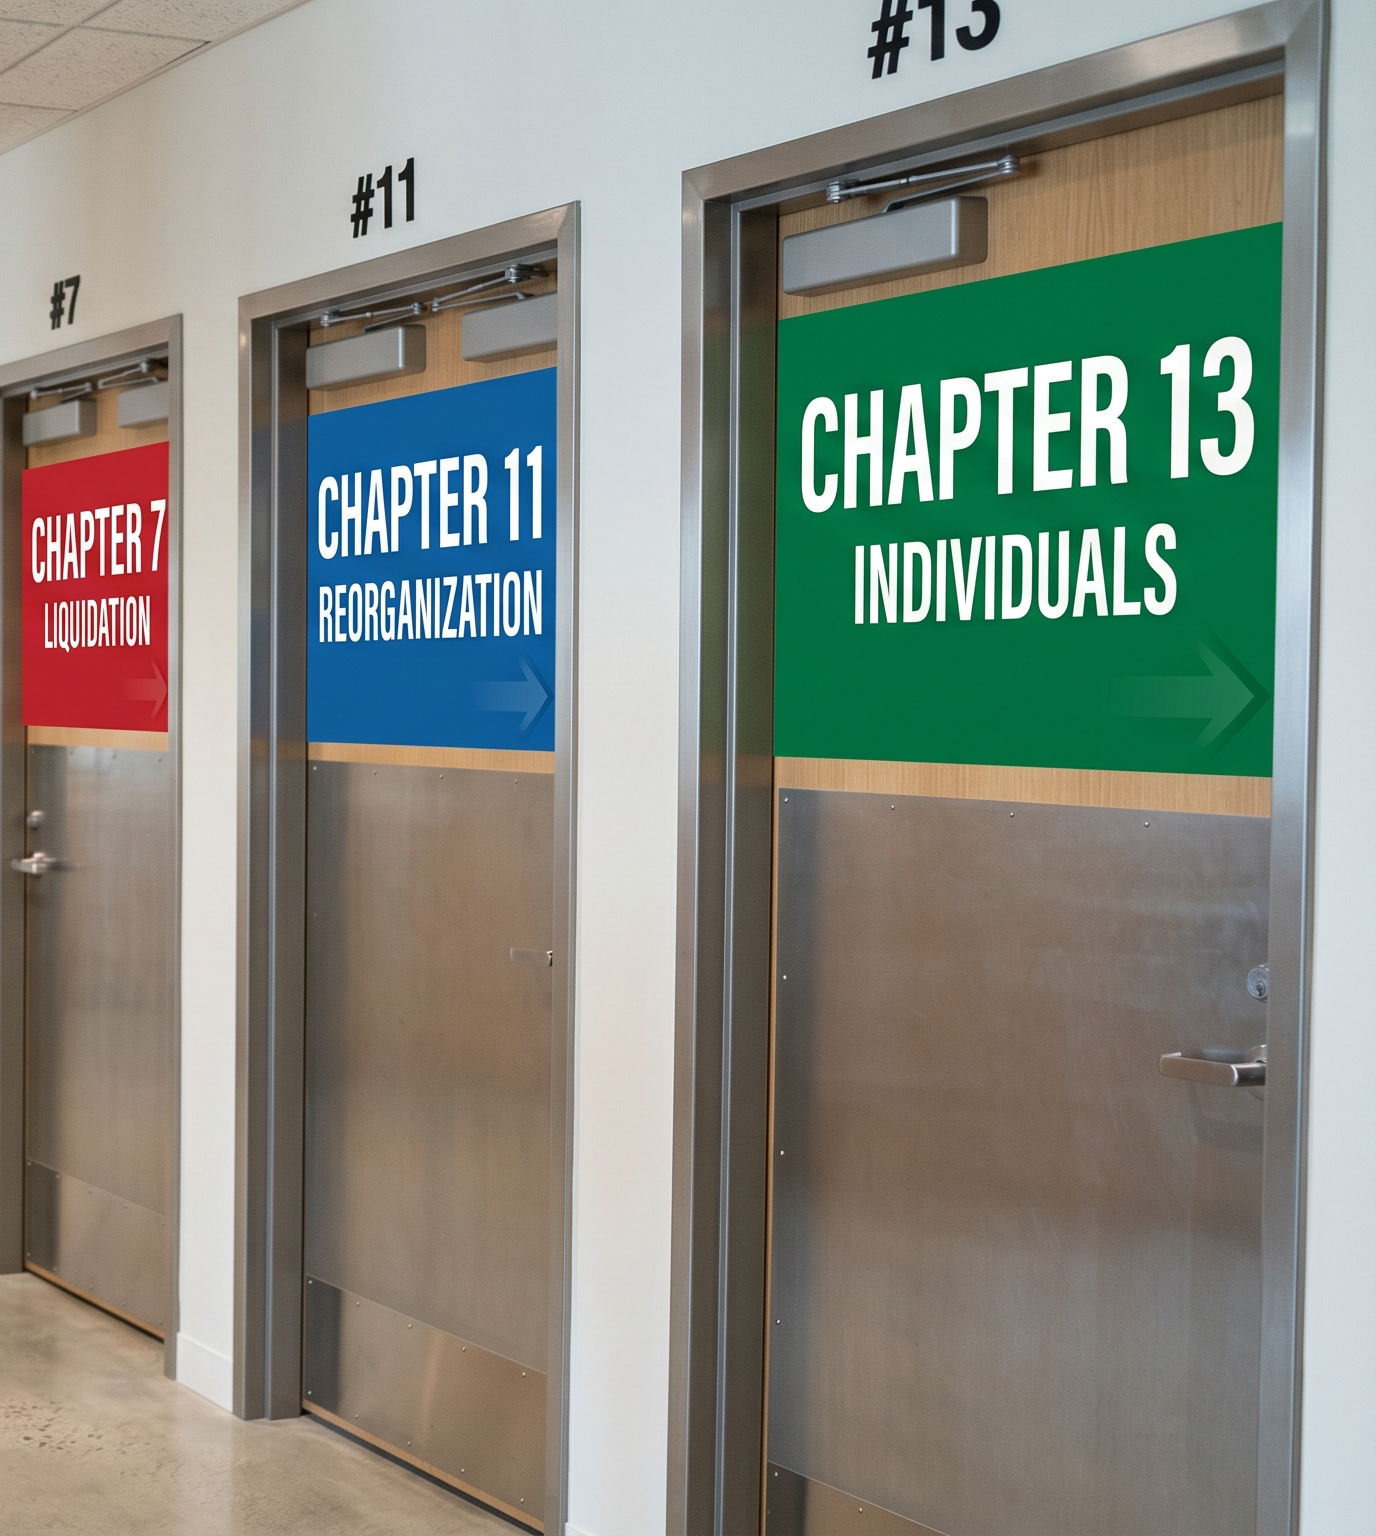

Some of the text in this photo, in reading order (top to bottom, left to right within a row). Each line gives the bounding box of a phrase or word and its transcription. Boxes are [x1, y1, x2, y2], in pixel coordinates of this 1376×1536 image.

[350, 157, 415, 239] #11
[49, 274, 81, 330] #7
[801, 336, 1255, 513] CHAPTER 13
[31, 498, 167, 584] CHAPTER 7
[318, 445, 543, 560] CHAPTER 11
[319, 569, 542, 643] REORGANIZATION
[854, 523, 1177, 625] INDIVIDUALS
[44, 595, 151, 653] LIQUIDATION
